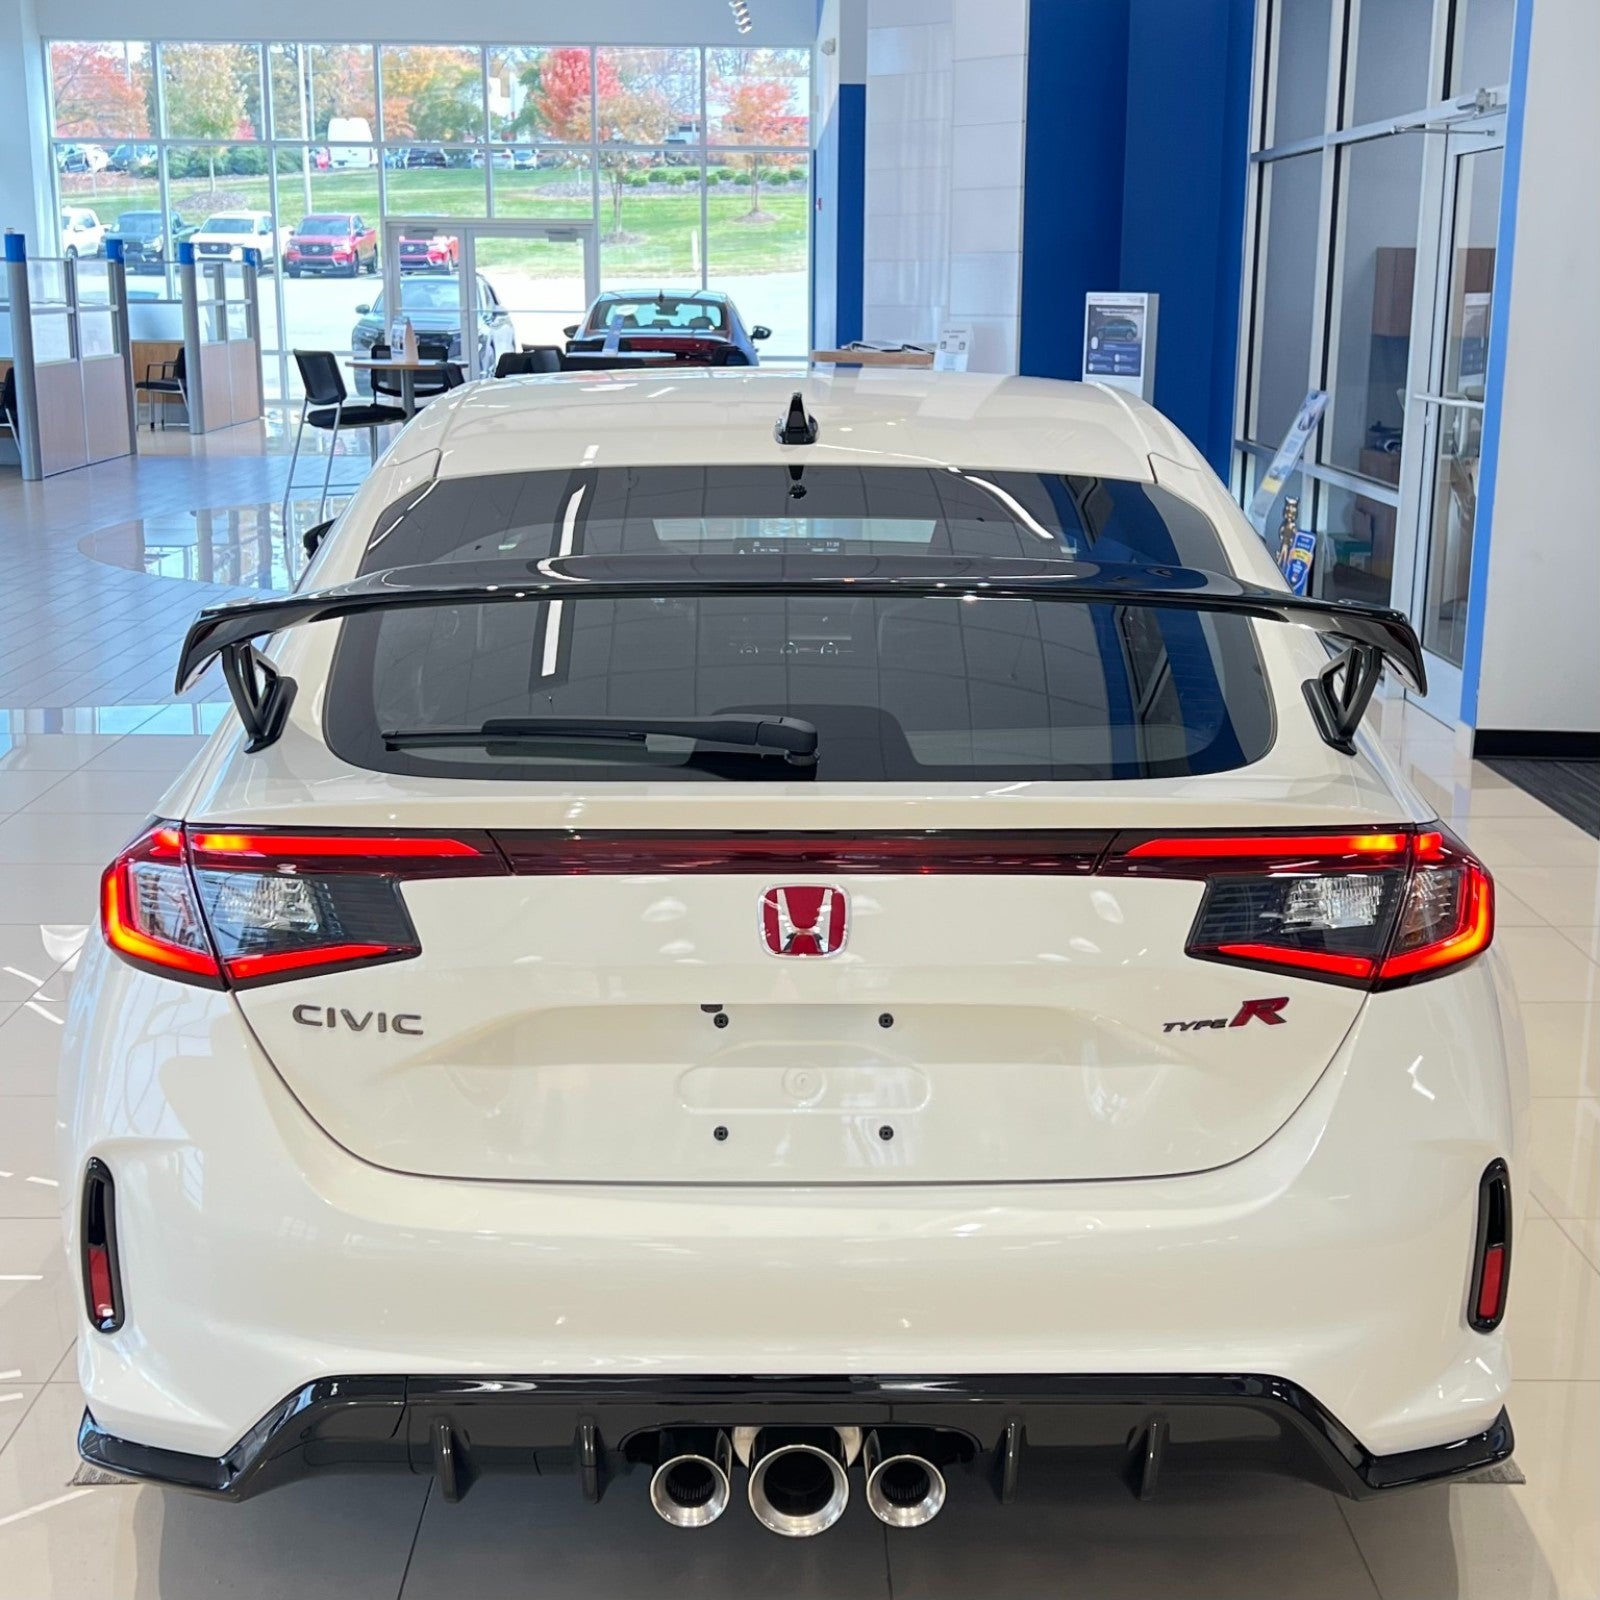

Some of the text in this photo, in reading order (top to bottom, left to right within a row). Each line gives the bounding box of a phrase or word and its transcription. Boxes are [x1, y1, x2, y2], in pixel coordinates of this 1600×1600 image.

[292, 1004, 424, 1035] CIVIC
[1162, 996, 1290, 1033] TYPE R
